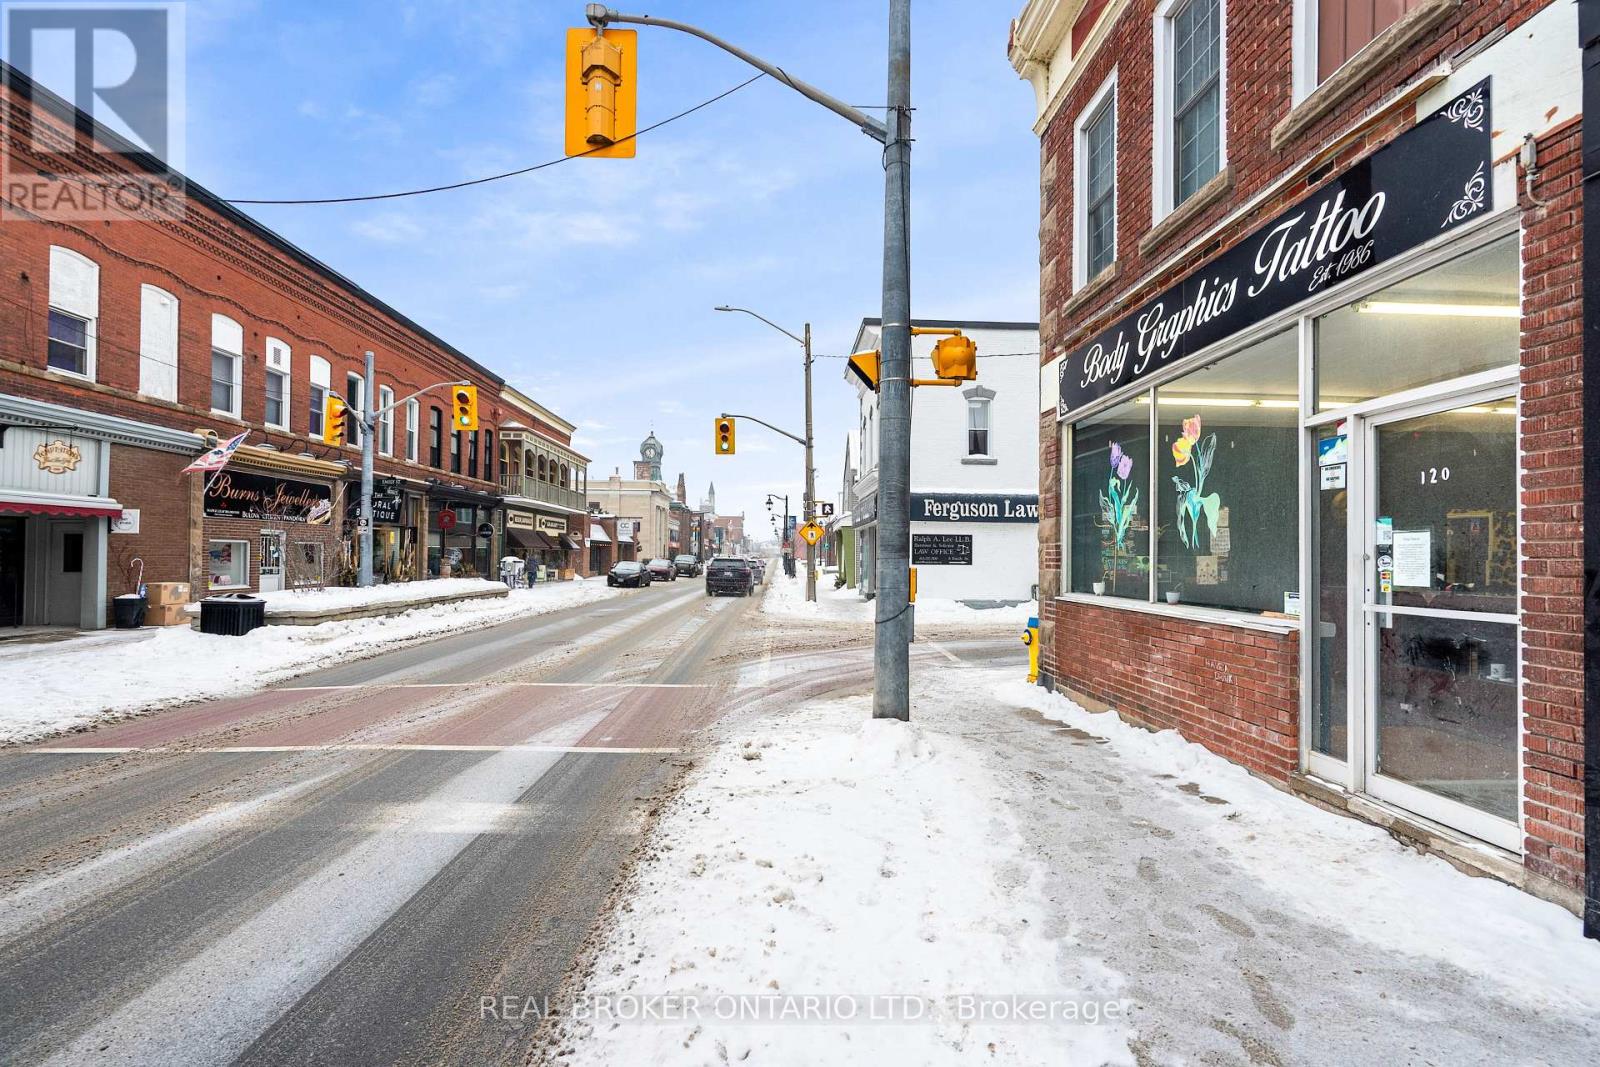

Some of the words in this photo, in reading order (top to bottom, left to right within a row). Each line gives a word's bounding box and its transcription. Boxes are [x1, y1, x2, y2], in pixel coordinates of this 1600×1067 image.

[1308, 262, 1336, 291] Est.
[1336, 239, 1374, 277] 1986
[1080, 331, 1129, 388] Body
[1134, 277, 1238, 374] Graphics
[1248, 189, 1386, 297] Tattoo
[209, 473, 259, 502] Burns
[1421, 467, 1450, 485] 120
[356, 508, 395, 519] BTIQUE
[924, 499, 998, 520] Ferguson
[1004, 500, 1038, 518] Law
